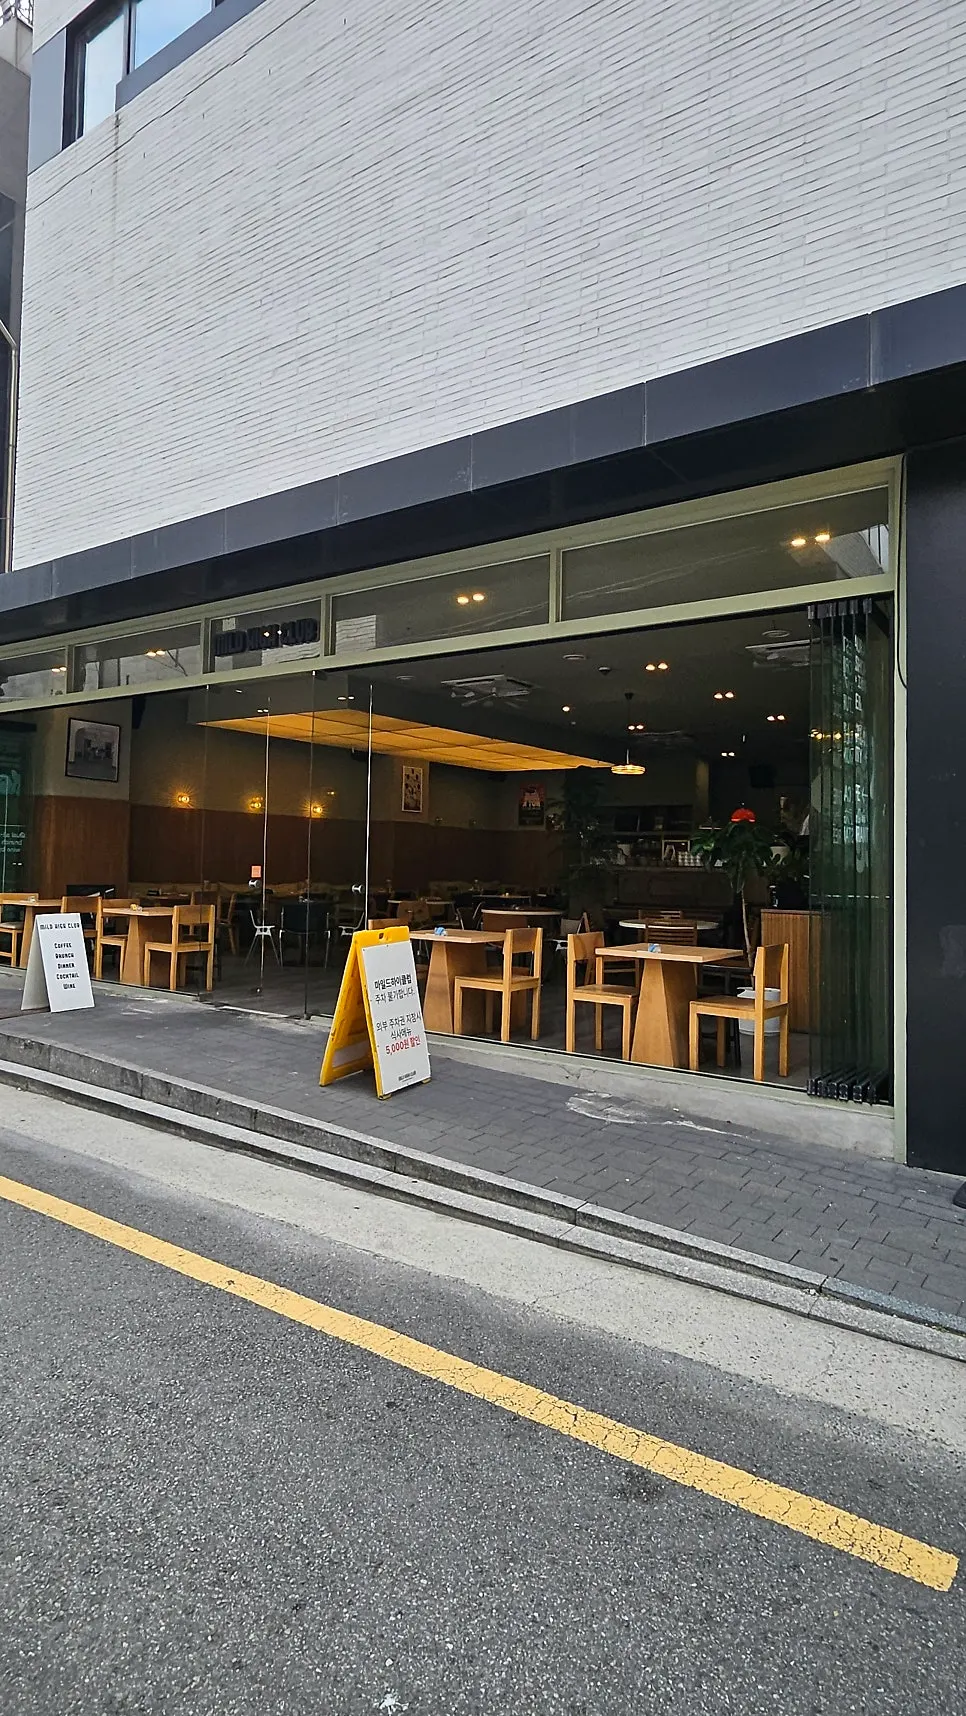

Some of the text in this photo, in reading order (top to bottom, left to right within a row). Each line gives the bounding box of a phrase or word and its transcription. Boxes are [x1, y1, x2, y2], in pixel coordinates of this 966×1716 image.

[374, 974, 412, 991] 마일드하이클럽
[375, 993, 387, 1004] 주차
[376, 1021, 388, 1032] 외부
[389, 1016, 405, 1029] 주차권
[390, 1028, 412, 1040] 식사메뉴
[385, 1036, 421, 1055] 5,000원 할인
